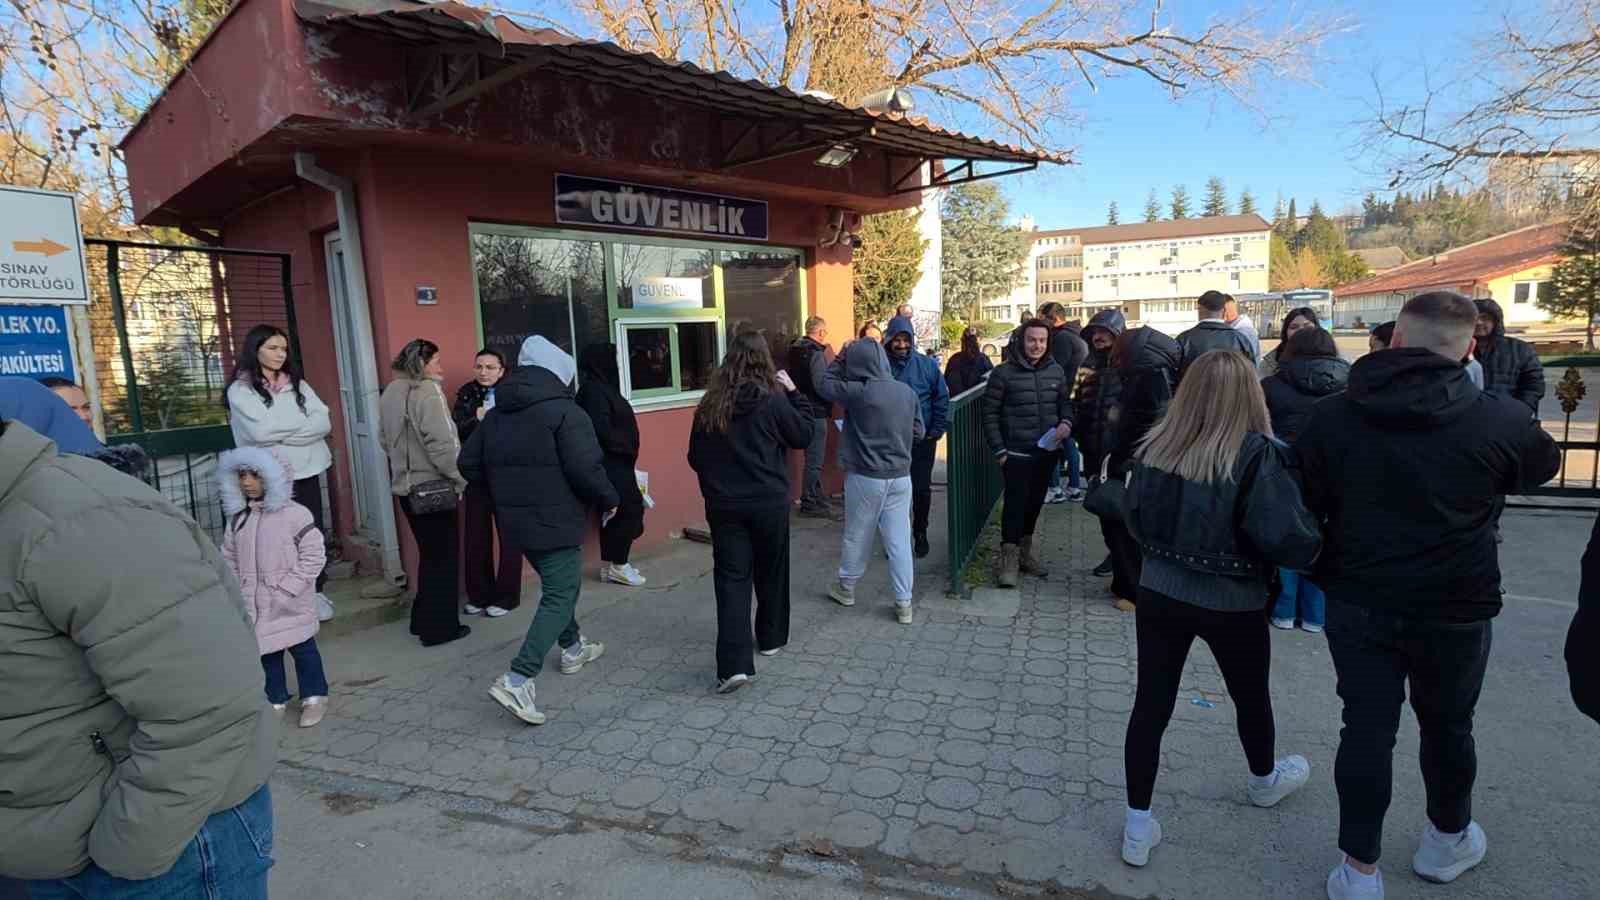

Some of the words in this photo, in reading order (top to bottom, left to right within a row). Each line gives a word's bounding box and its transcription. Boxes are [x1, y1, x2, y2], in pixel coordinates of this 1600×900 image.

[590, 185, 746, 235] GÜVENLİK
[1, 263, 48, 275] SINAV
[32, 316, 61, 334] Y.O.
[0, 350, 65, 374] AKÜLTESİ
